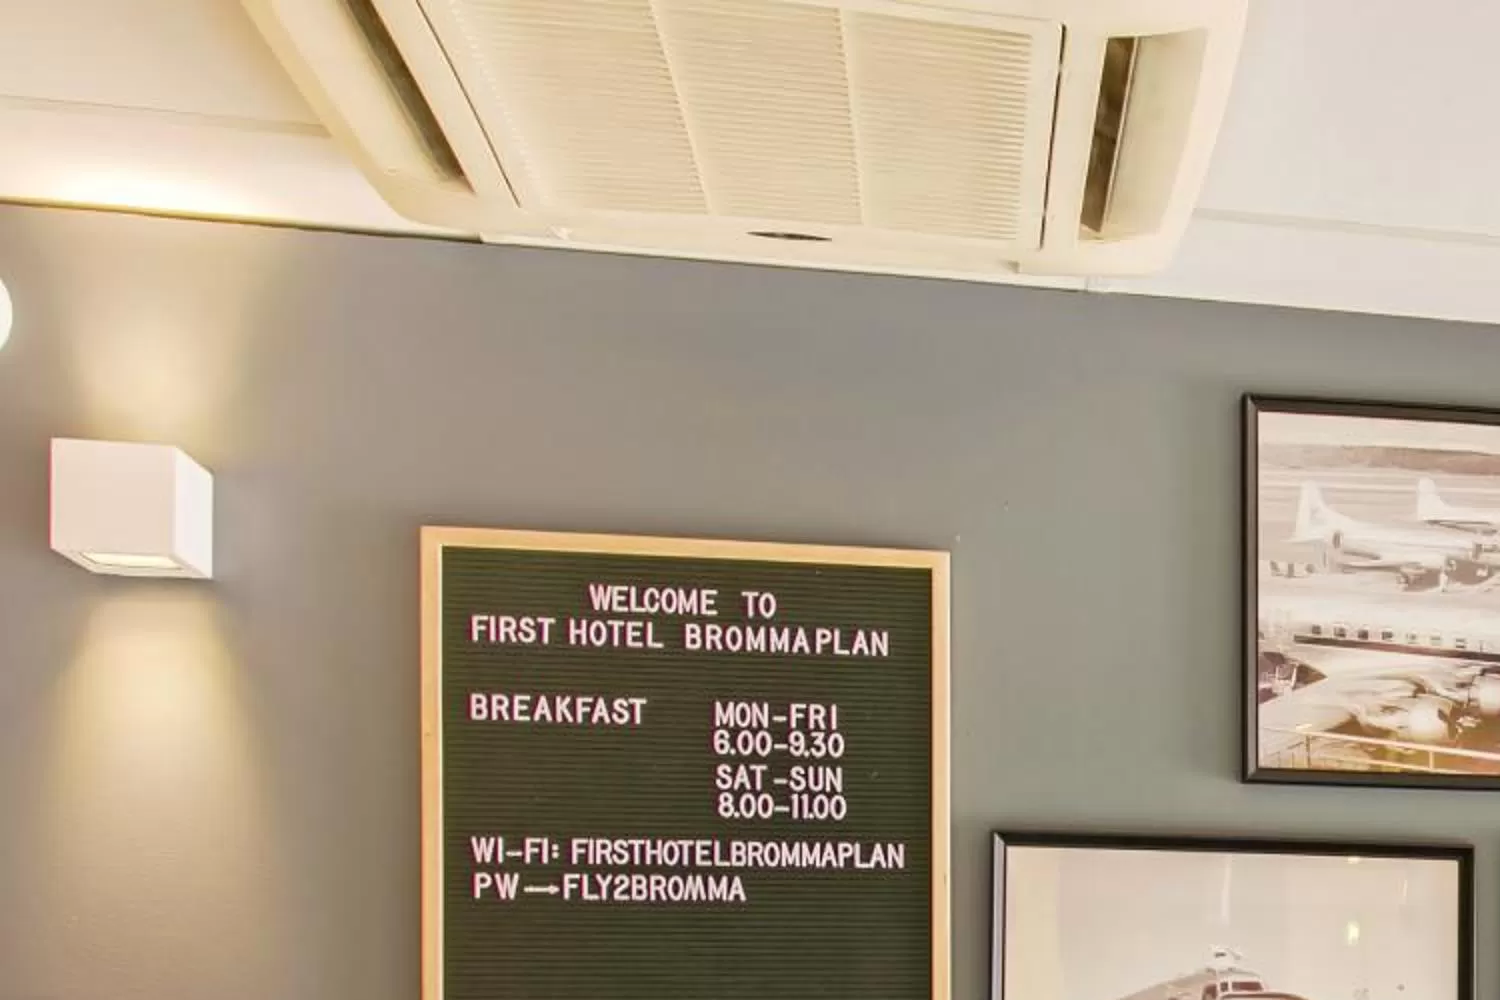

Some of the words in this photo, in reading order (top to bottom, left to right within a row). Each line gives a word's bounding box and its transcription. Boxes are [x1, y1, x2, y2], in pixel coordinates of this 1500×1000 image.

[589, 584, 718, 616] WELCOME
[741, 591, 777, 619] TO
[471, 615, 556, 645] FIRST
[569, 618, 665, 649] HOTEL
[685, 623, 889, 657] BROMMAPLAN
[471, 693, 648, 725] BREAKFAST
[715, 701, 837, 730] MON-FRI
[713, 729, 845, 758] 6.00-9.30
[718, 791, 847, 821] 8.00-11.00
[471, 836, 560, 865] WI-FI:
[571, 838, 905, 869] FIRSTHOTELBROMMAPLAN
[474, 872, 520, 900] PW
[563, 873, 747, 902] FLY2BROMMA
